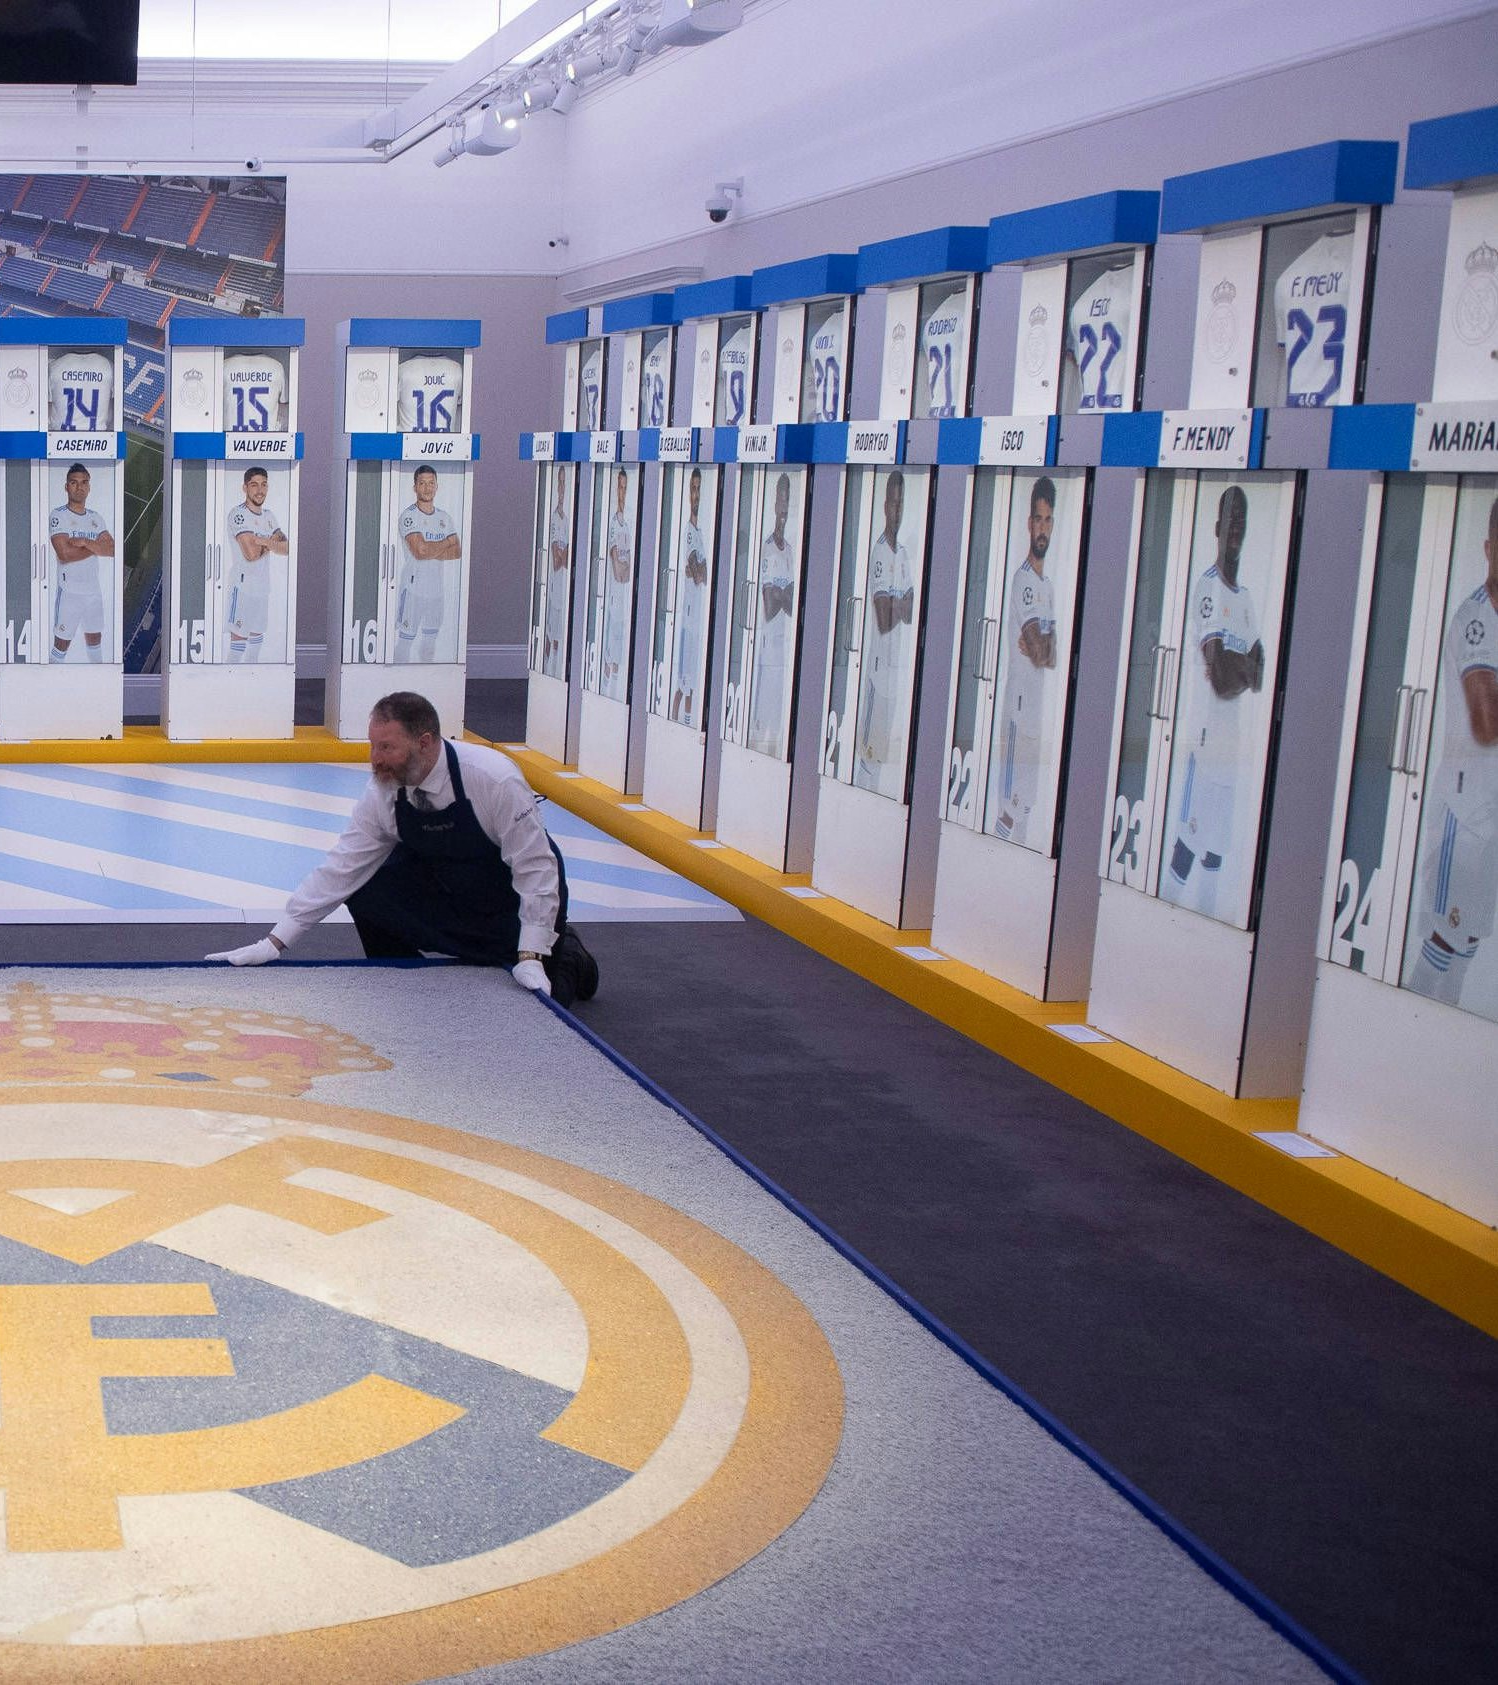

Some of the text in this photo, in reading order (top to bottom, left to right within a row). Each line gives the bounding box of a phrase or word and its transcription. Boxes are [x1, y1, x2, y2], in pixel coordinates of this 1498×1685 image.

[61, 370, 103, 383] CASEMIRO
[230, 371, 273, 383] VALVERDE
[1078, 321, 1123, 408] 22
[1285, 304, 1348, 408] 23
[929, 342, 956, 418] 21
[60, 388, 100, 431] 14
[231, 386, 270, 432] 15
[412, 389, 455, 432] 16
[233, 439, 287, 452] VALVERDE
[854, 433, 889, 452] RODRYGO
[1172, 425, 1235, 452] F.MENDY
[5, 618, 32, 664] 14
[178, 619, 205, 664] 15
[351, 619, 378, 664] 16
[1108, 794, 1147, 892] 23
[1330, 858, 1388, 980] 24
